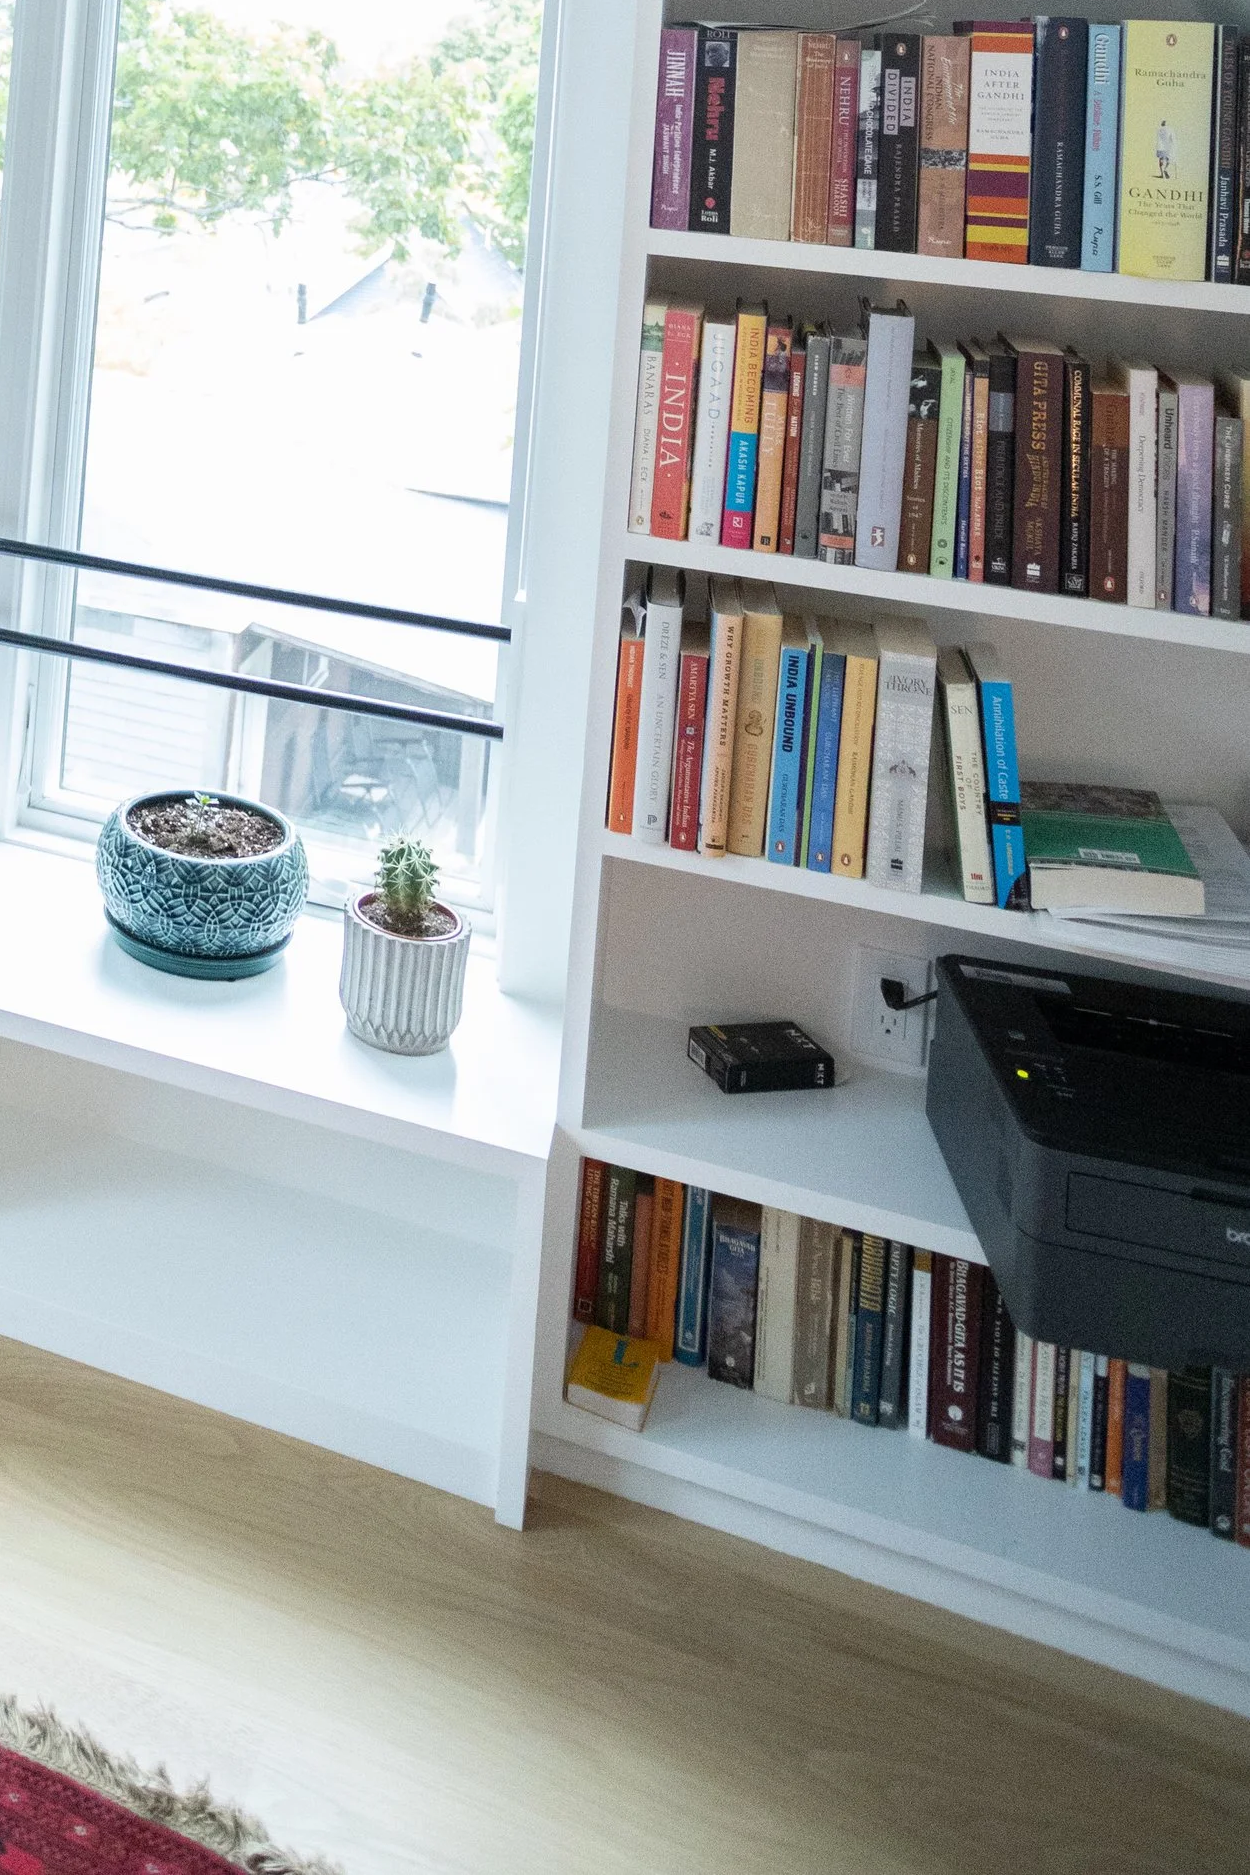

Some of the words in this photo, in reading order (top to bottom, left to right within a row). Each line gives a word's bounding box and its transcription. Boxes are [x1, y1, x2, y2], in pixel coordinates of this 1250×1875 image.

[665, 50, 686, 97] JINNAH
[927, 45, 935, 95] NATIONAL
[984, 69, 1020, 78] INDIA
[1094, 33, 1110, 85] Gandhi
[1134, 68, 1207, 80] Ramachandra
[935, 76, 943, 110] INDIAN
[977, 92, 1025, 101] GANDHI
[983, 81, 1020, 89] AFTER
[1156, 79, 1185, 88] Guha
[705, 77, 725, 141] Nehru
[839, 76, 852, 125] NEHRU
[886, 72, 898, 132] DIVIDED
[902, 79, 913, 122] INDIA
[865, 109, 875, 155] CHOCOLATE
[924, 97, 933, 141] CONGRESS
[707, 166, 715, 190] Akbar
[863, 156, 872, 174] CAKE
[1054, 141, 1063, 205] RAMACHANDRA
[840, 179, 849, 218] SHASHI
[1128, 186, 1203, 203] GANDHI
[1137, 200, 1153, 208] The
[1155, 201, 1175, 209] Years
[1219, 176, 1231, 213] Janhavi
[701, 215, 718, 223] Roli
[1128, 208, 1163, 219] Changed
[1218, 214, 1229, 247] Prasada
[750, 327, 759, 358] INDIA
[643, 356, 657, 415] BANARAS
[708, 333, 726, 420] JUGAAD
[744, 360, 758, 424] BECOMING
[1033, 361, 1049, 396] GITA
[1073, 369, 1082, 421] COMMUNAL
[659, 373, 687, 467] INDIA
[1030, 401, 1048, 451] PRESS
[1072, 422, 1082, 445] RAGE
[1163, 407, 1176, 449] Unheard
[738, 440, 750, 472] AKASH
[735, 473, 746, 505] KAPUR
[1071, 459, 1081, 493] SECULAR
[1070, 494, 1079, 518] INDIA
[727, 626, 735, 646] WHY
[658, 664, 667, 680] SEN
[687, 660, 697, 702] AMARTYA
[724, 652, 733, 694] GROWTH
[786, 655, 800, 688] INDIA
[892, 676, 927, 686] IVORY
[884, 681, 932, 696] THRONE
[686, 702, 694, 726] SEN
[719, 698, 730, 746] MATTERS
[781, 693, 797, 753] UNBOUND
[950, 704, 973, 715] SEN
[652, 710, 664, 764] UNCERTAIN
[991, 696, 1006, 758] Annihilation
[649, 765, 660, 801] GLORY
[955, 755, 964, 780] FIRST
[997, 761, 1006, 775] of
[956, 786, 967, 811] BOYS
[973, 773, 984, 816] COUNTRY
[998, 776, 1009, 800] Caste
[681, 800, 690, 828] Indian
[786, 1029, 816, 1050] NXT
[609, 1178, 620, 1222] Ramana
[619, 1201, 629, 1225] Talks
[605, 1223, 617, 1264] Maharshi
[616, 1227, 625, 1247] with
[887, 1279, 897, 1315] LOGIC
[956, 1346, 966, 1368] AS
[953, 1380, 965, 1394] IS
